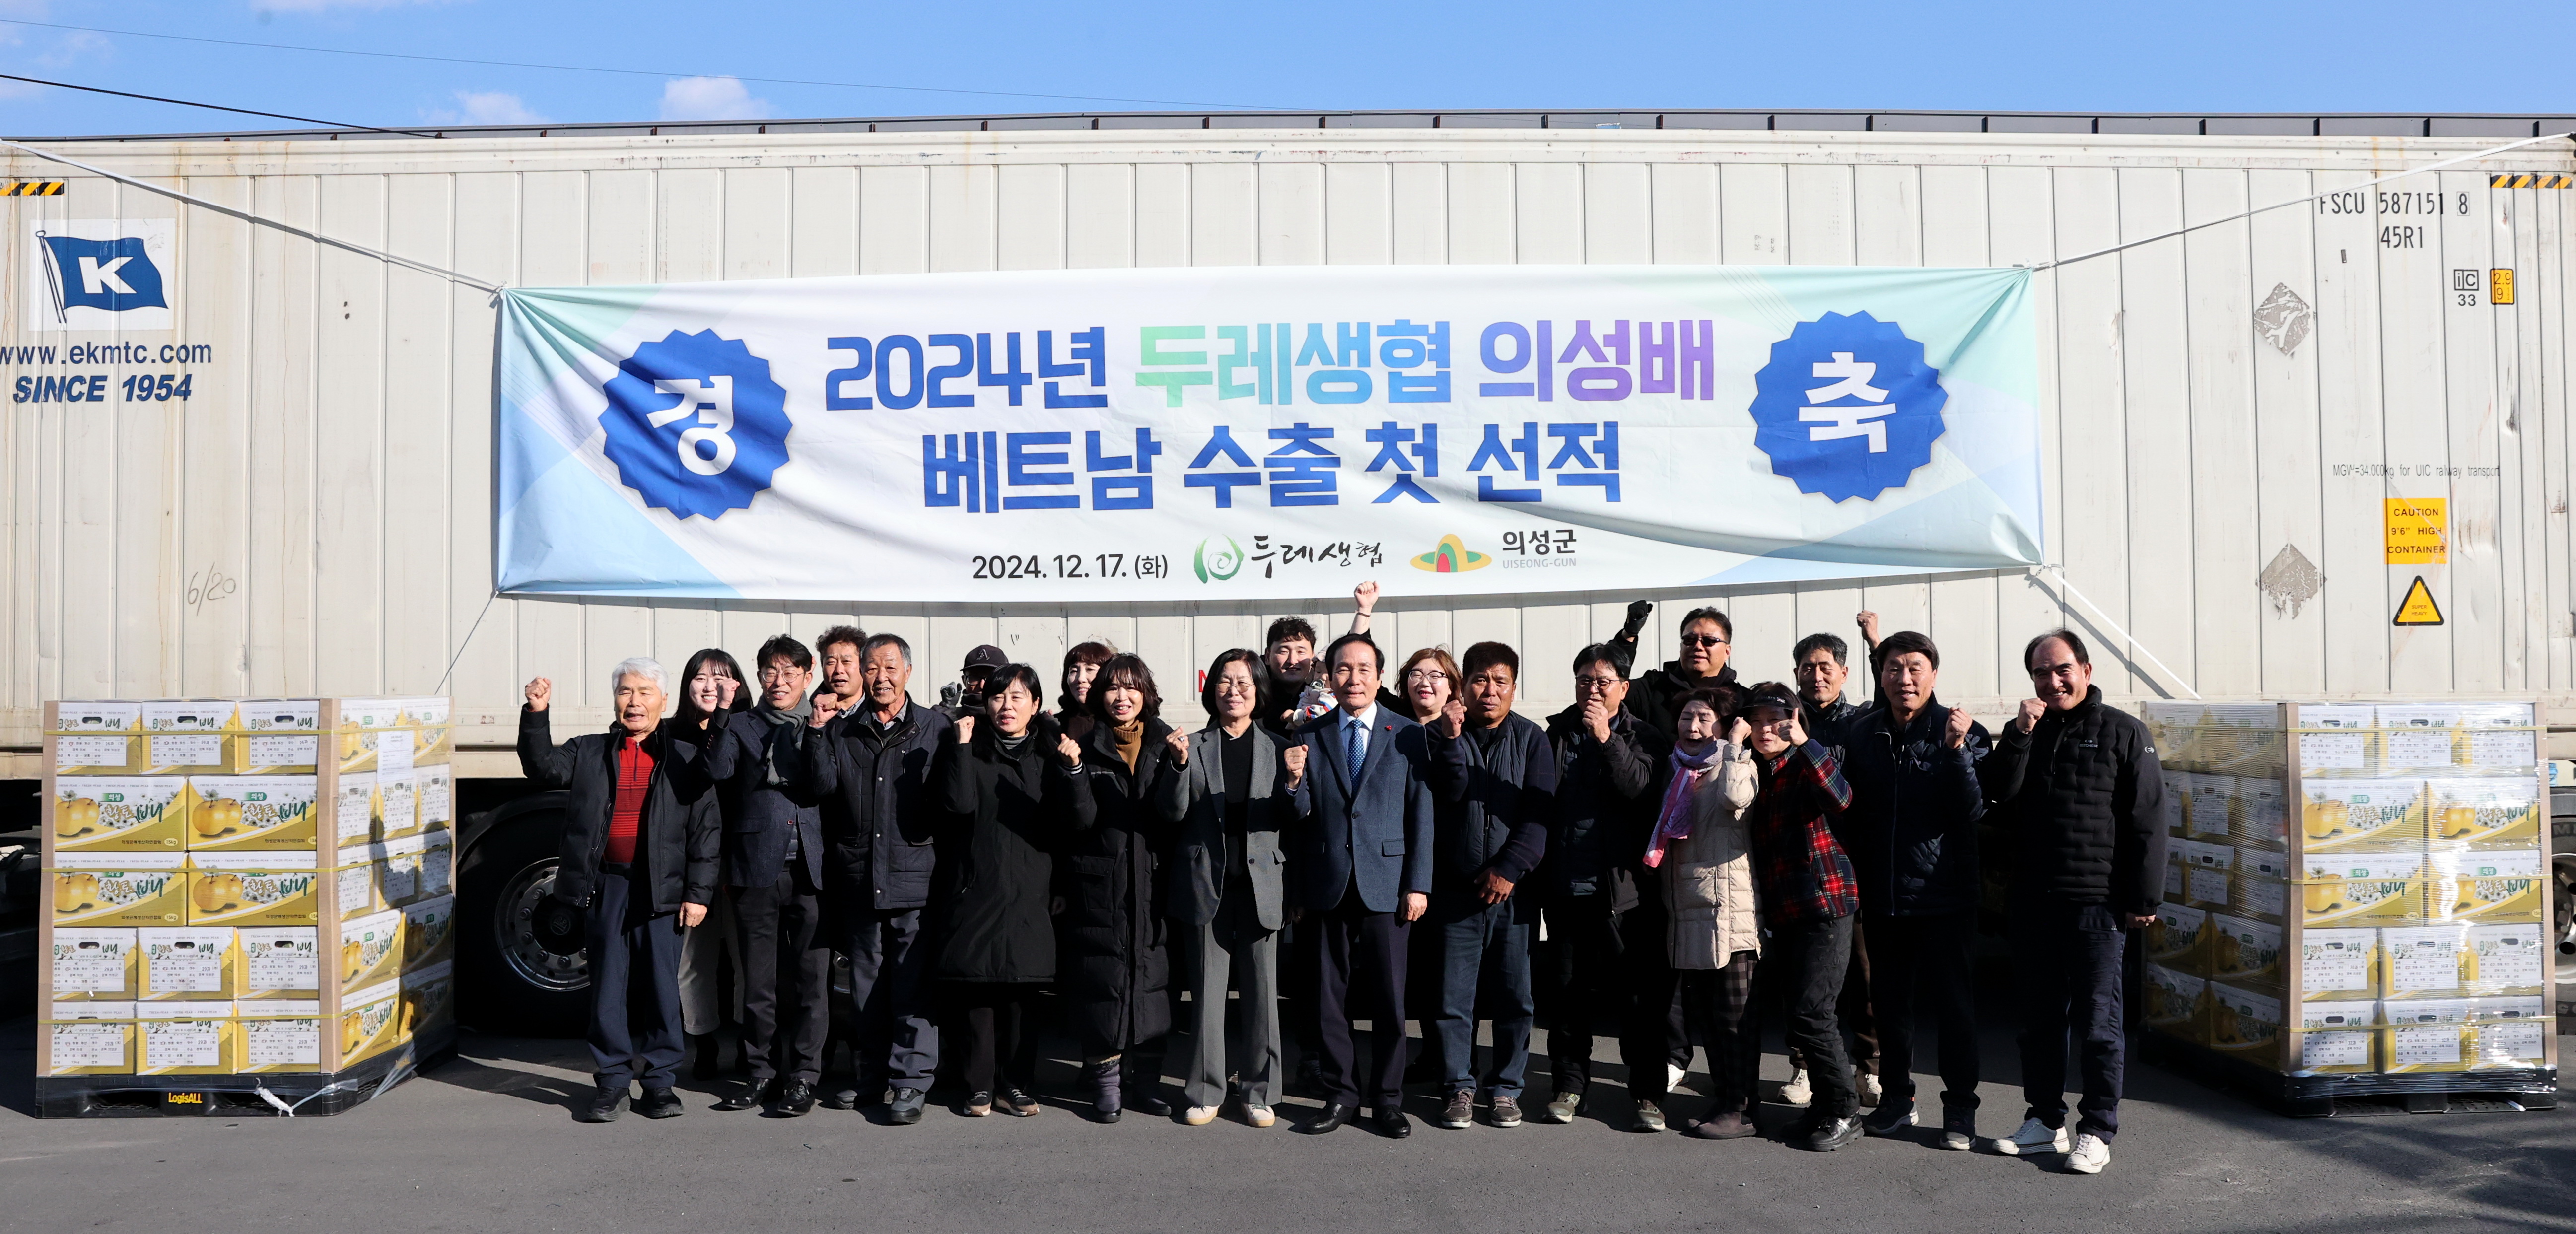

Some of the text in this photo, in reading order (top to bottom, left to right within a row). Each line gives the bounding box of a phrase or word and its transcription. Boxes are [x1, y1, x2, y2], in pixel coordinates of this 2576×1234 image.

[2379, 192, 2443, 214] 587151
[2459, 193, 2467, 214] 8
[2380, 226, 2423, 248] 45R1
[78, 257, 137, 294] K
[2494, 273, 2511, 285] 2.9
[2458, 294, 2476, 306] 33
[0, 341, 212, 365] www.ekmtc.com
[826, 319, 1713, 410] 2024년 두레생협 의성배
[13, 374, 192, 403] SINCE 1954
[1798, 351, 1896, 453] 축
[647, 375, 737, 476] 경
[923, 421, 1621, 513] 베트남 수출 첫 선적
[2400, 464, 2410, 476] for
[2416, 464, 2430, 476] UIC
[2394, 508, 2438, 517] CAUTION
[1502, 529, 1577, 556] 의성군
[2387, 546, 2445, 554] CONTAINER
[972, 554, 1168, 580] 2024. 12. 17. (화)
[1502, 559, 1576, 568] UISEONG-GUN
[187, 562, 236, 617] 6/20
[105, 804, 134, 820] 황토
[248, 803, 277, 819] 황토
[105, 879, 134, 896] 황토
[249, 879, 278, 895] 황토
[168, 1092, 202, 1104] LogisALL
